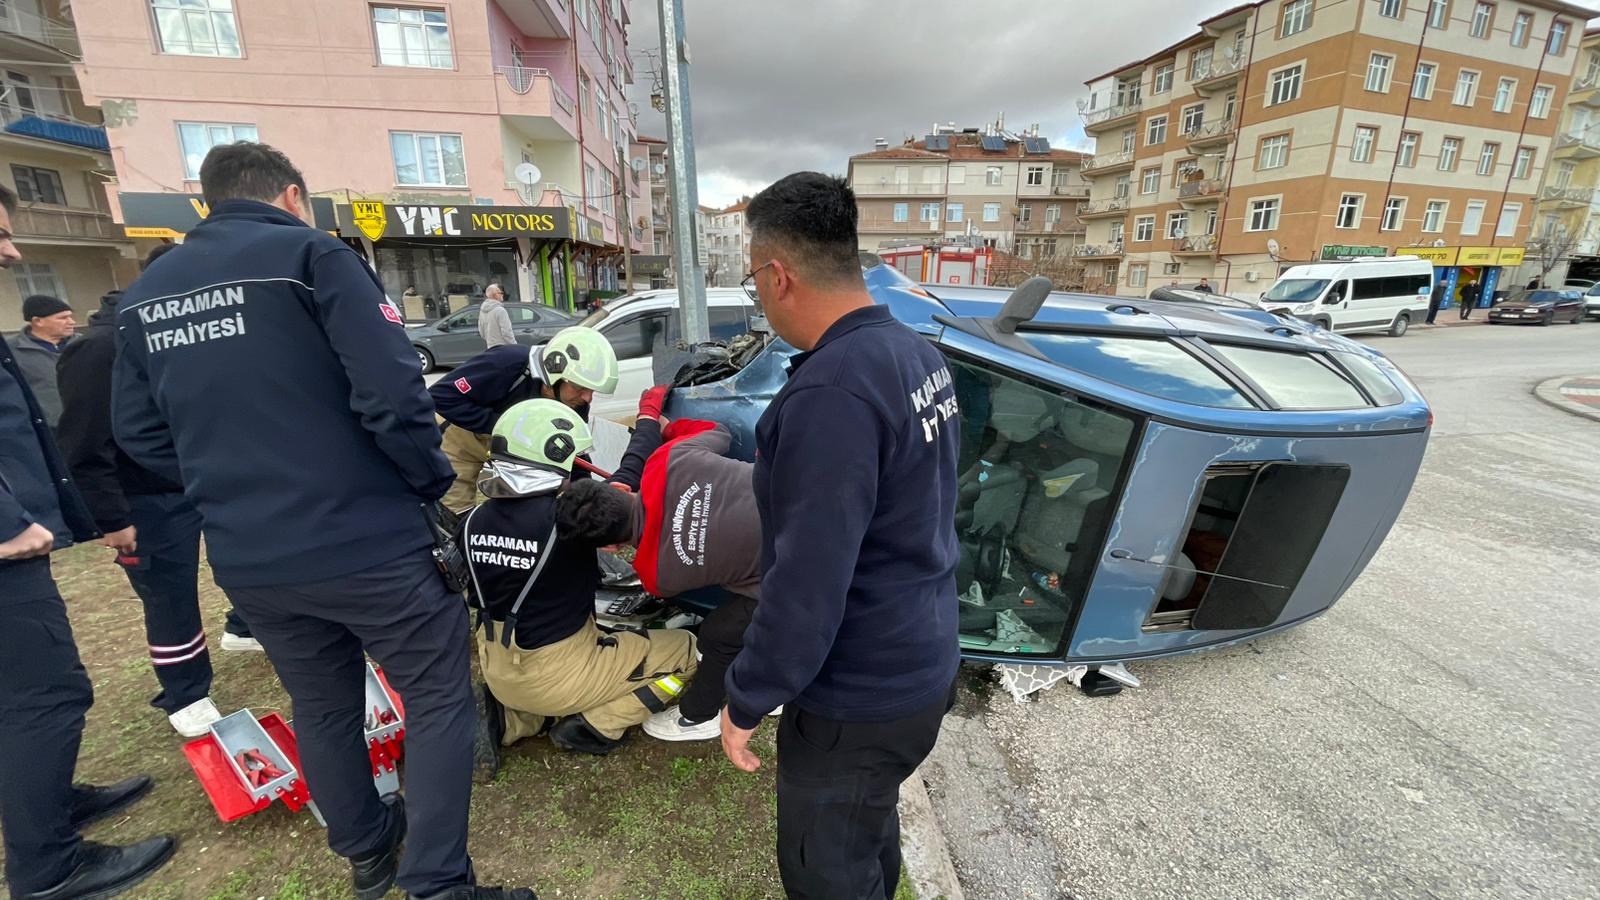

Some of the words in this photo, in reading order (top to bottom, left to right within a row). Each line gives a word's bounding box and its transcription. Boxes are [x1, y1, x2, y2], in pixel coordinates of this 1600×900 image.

[394, 206, 461, 235] YNC
[471, 212, 555, 232] MOTORS
[138, 286, 245, 325] KARAMAN
[146, 312, 246, 353] İTFAİYESİ
[692, 499, 702, 518] MYO
[470, 534, 538, 553] KARAMAN
[688, 520, 699, 551] ESPİYE
[471, 549, 536, 570] İTFAİYESİ
